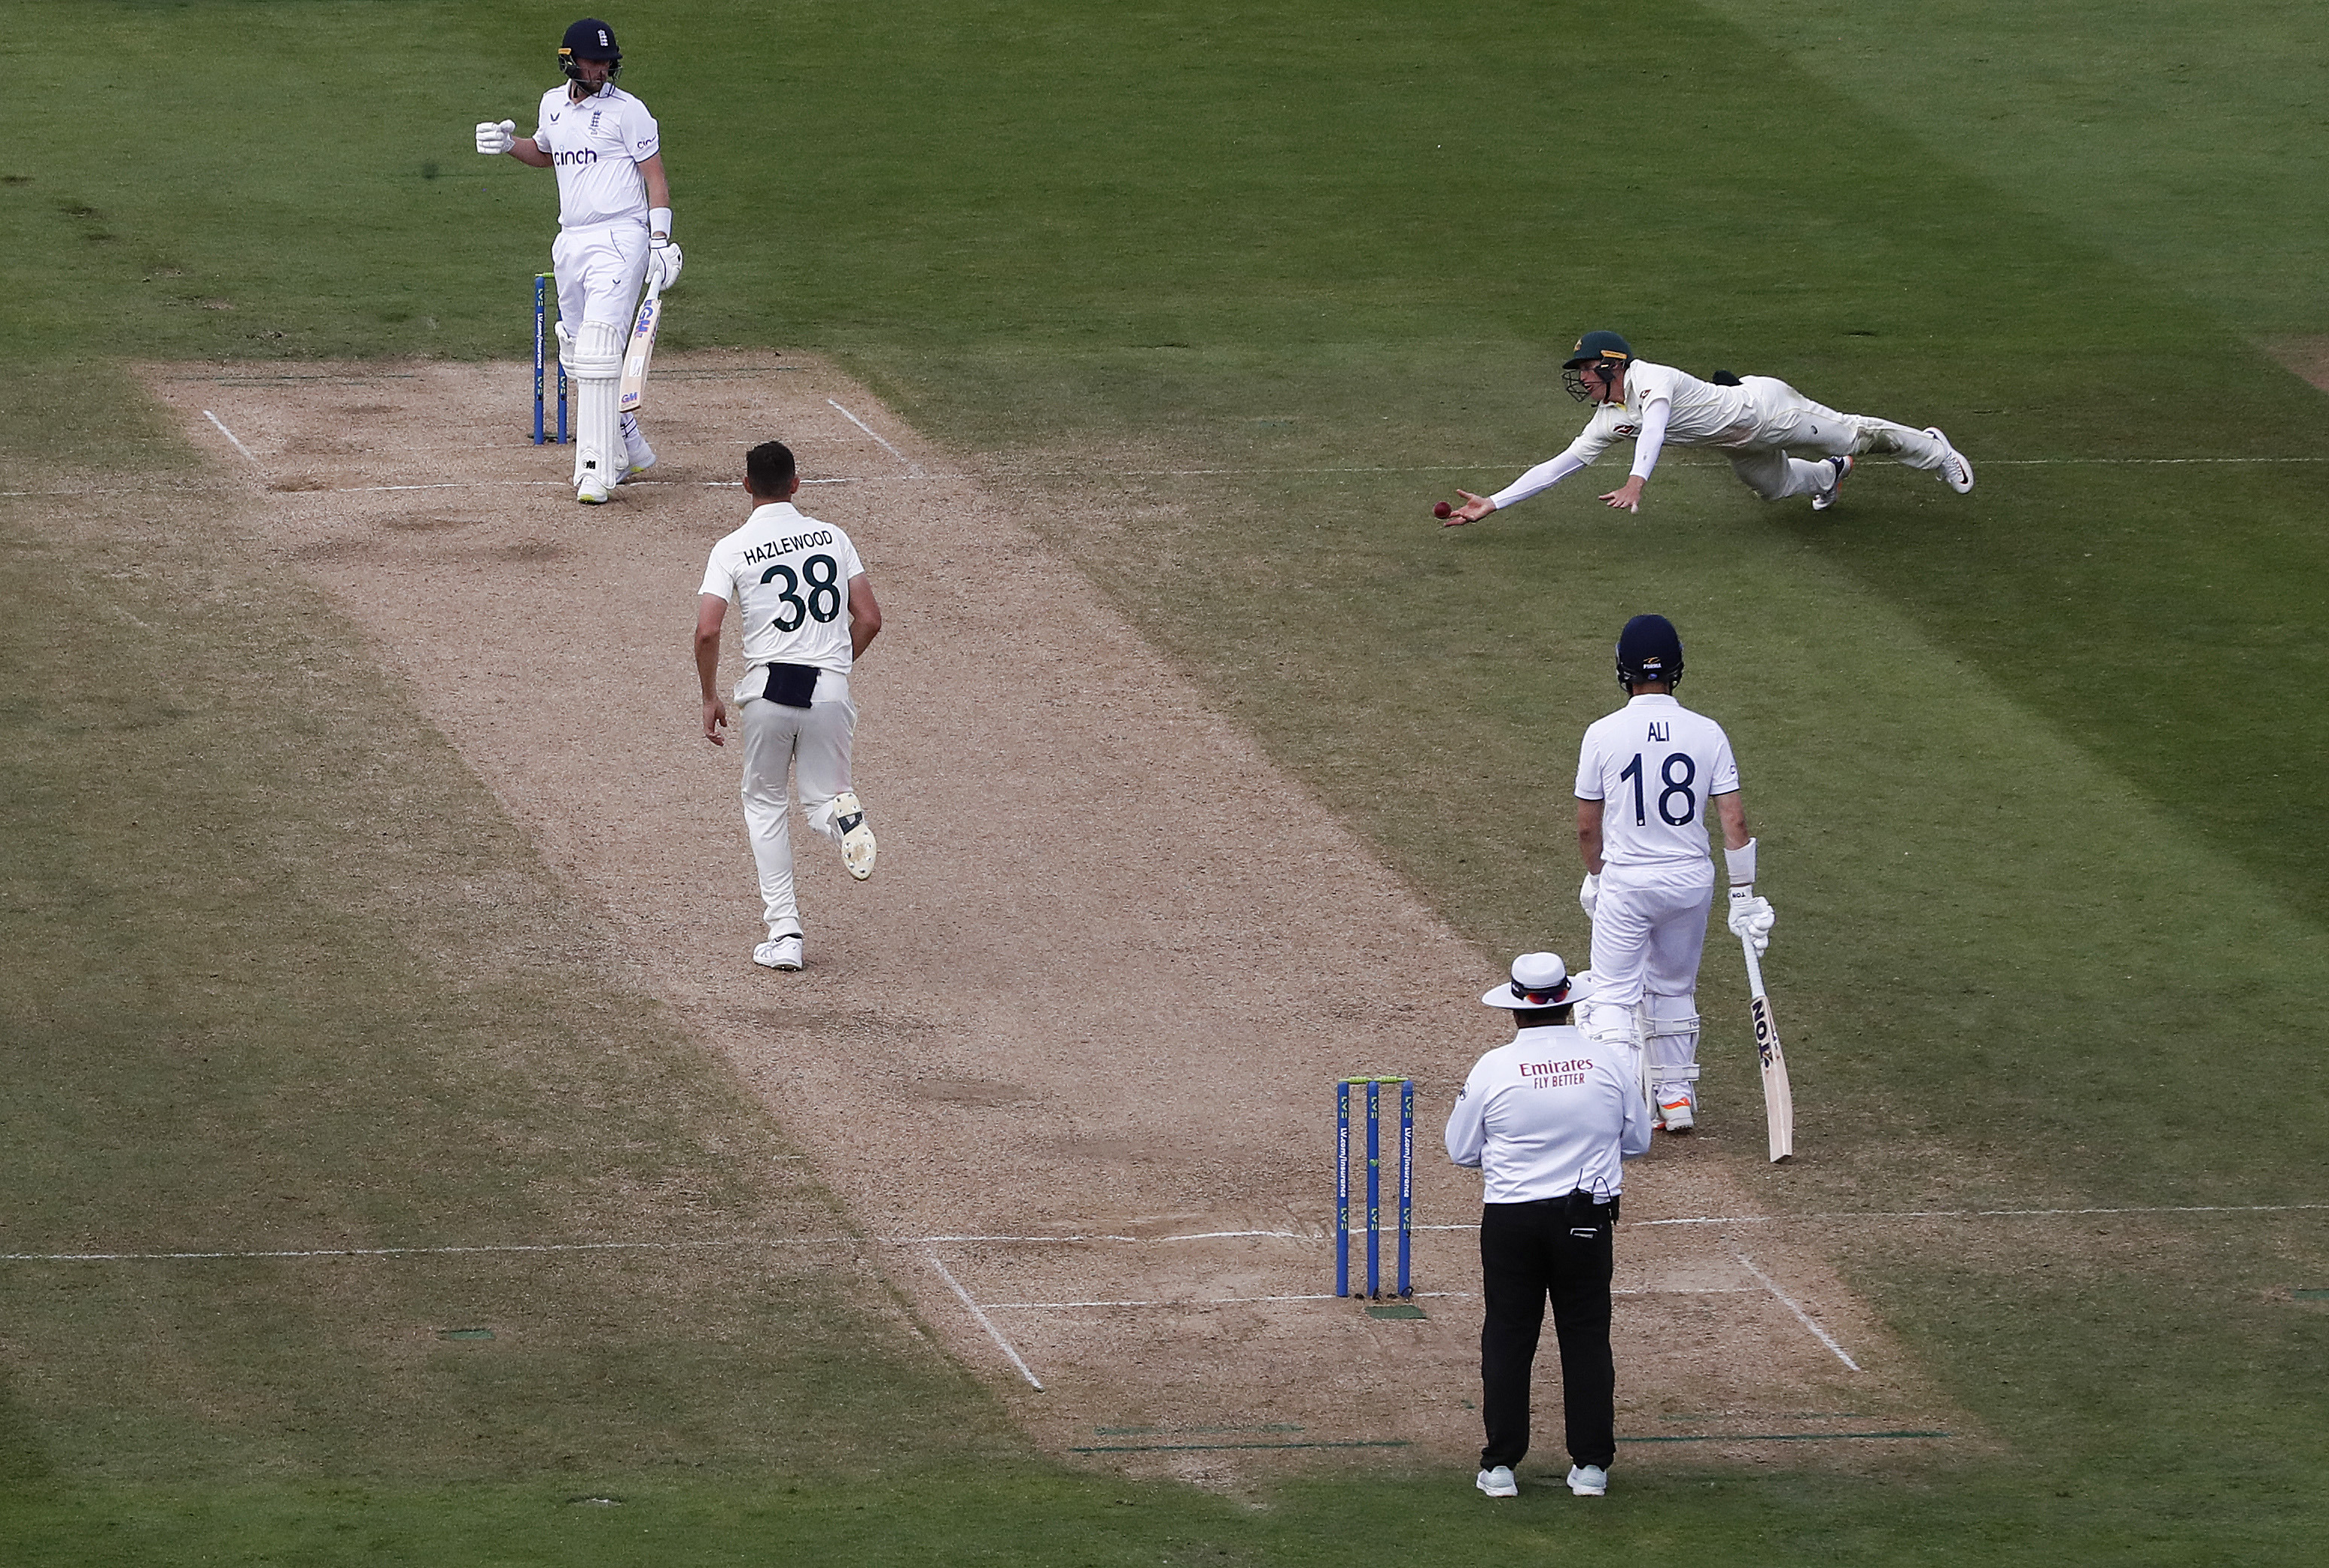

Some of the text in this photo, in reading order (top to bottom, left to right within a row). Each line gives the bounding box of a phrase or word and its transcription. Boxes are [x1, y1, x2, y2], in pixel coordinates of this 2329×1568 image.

[554, 145, 597, 166] cinch
[622, 392, 637, 403] GM
[743, 530, 832, 566] HAZLEWOOD
[760, 555, 841, 632] 38
[1647, 722, 1669, 742] ALI
[1620, 752, 1695, 826] 18
[1519, 1059, 1593, 1077] Emirates
[1534, 1073, 1585, 1089] FLY BETTER
